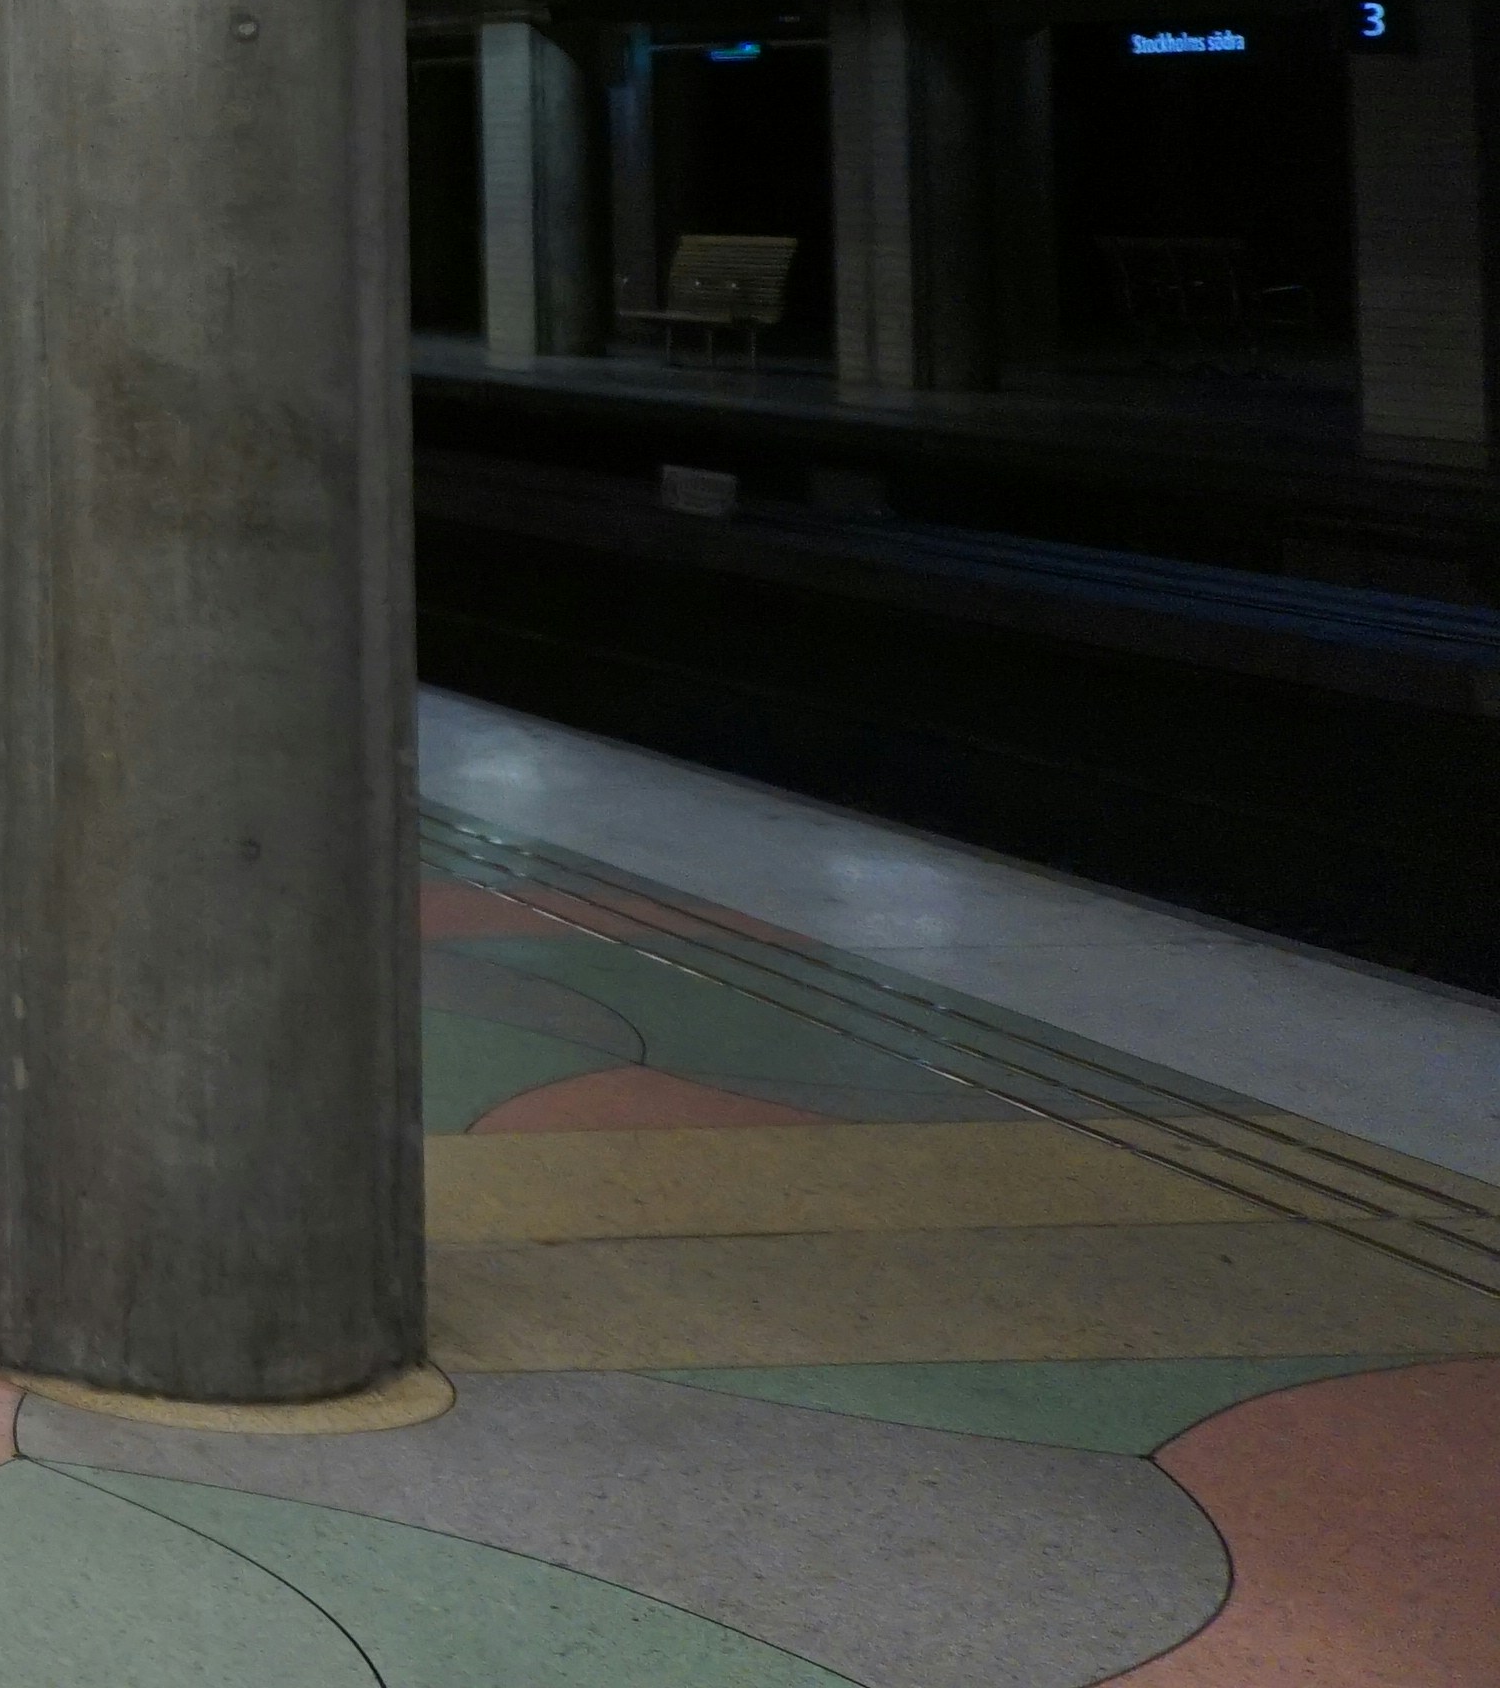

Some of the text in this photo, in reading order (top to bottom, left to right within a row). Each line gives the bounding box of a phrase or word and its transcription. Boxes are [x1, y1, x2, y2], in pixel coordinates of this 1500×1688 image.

[1363, 2, 1385, 37] 3
[1131, 30, 1245, 54] Stockholms södra
